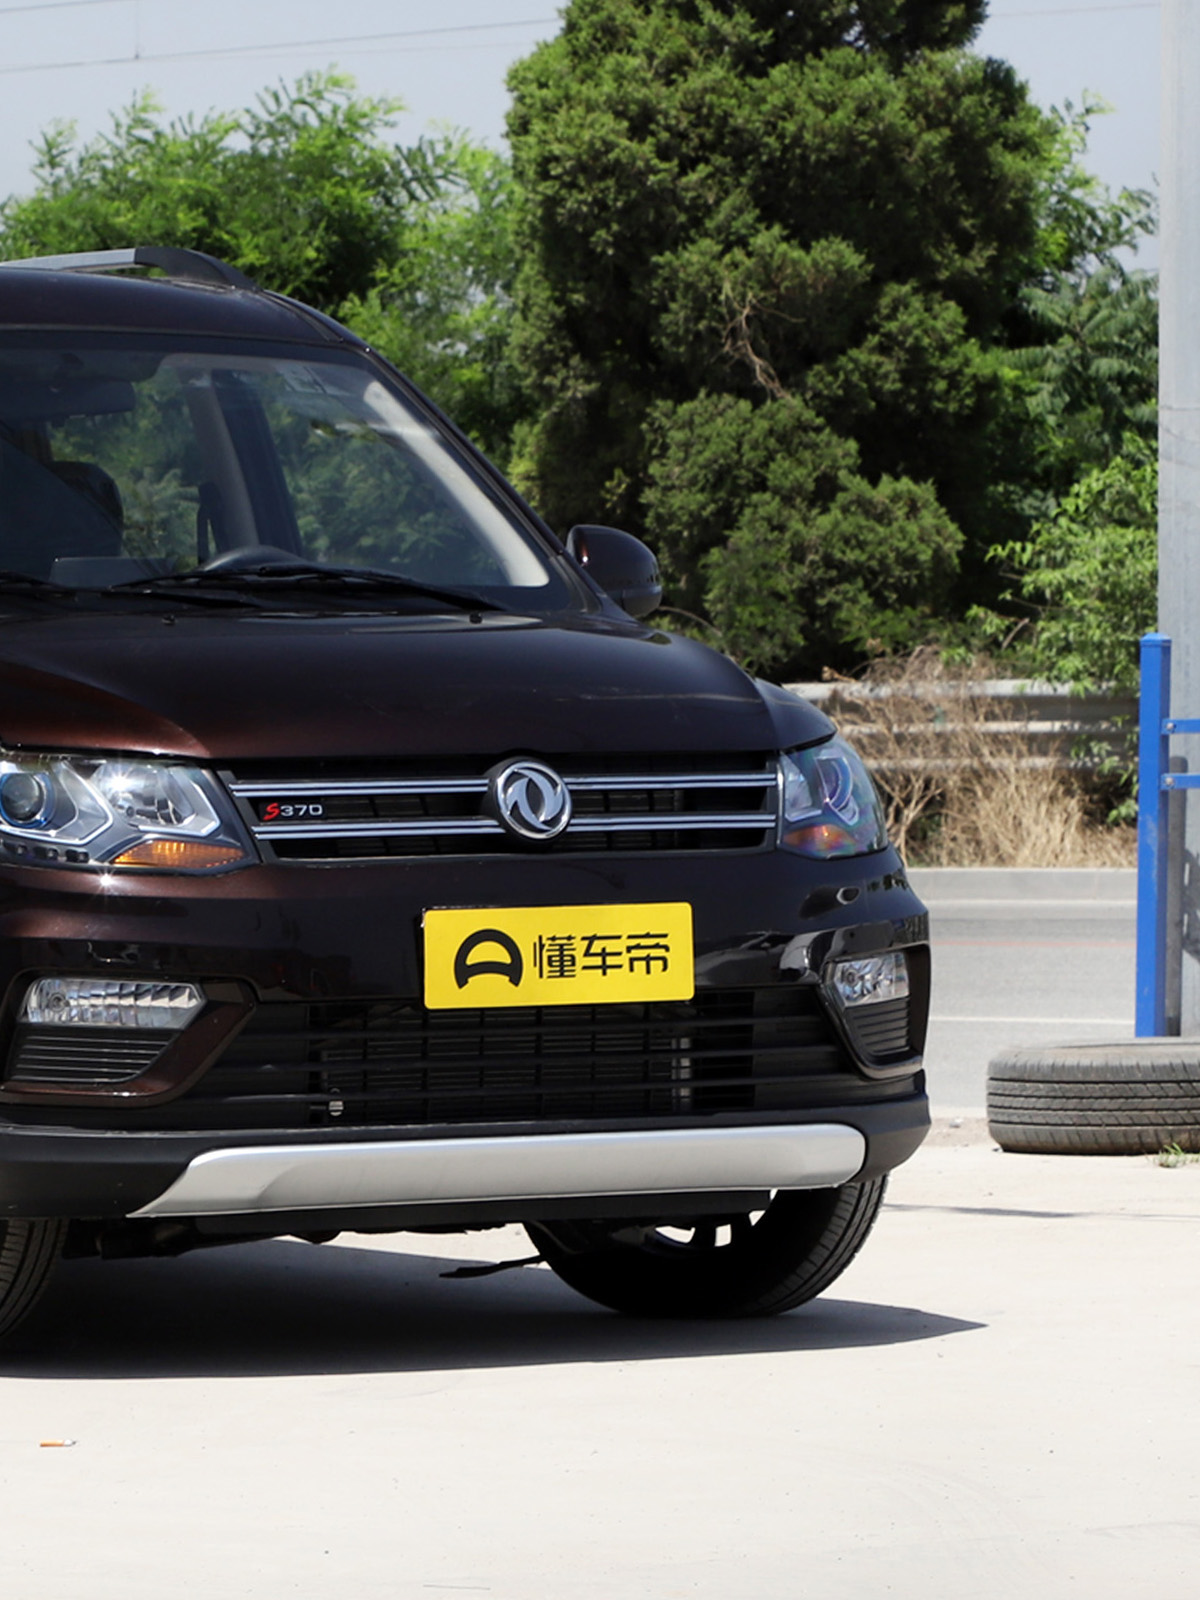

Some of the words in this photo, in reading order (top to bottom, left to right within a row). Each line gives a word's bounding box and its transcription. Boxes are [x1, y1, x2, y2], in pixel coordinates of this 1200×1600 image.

[263, 802, 323, 821] S370
[533, 932, 670, 979] 懂车帝
